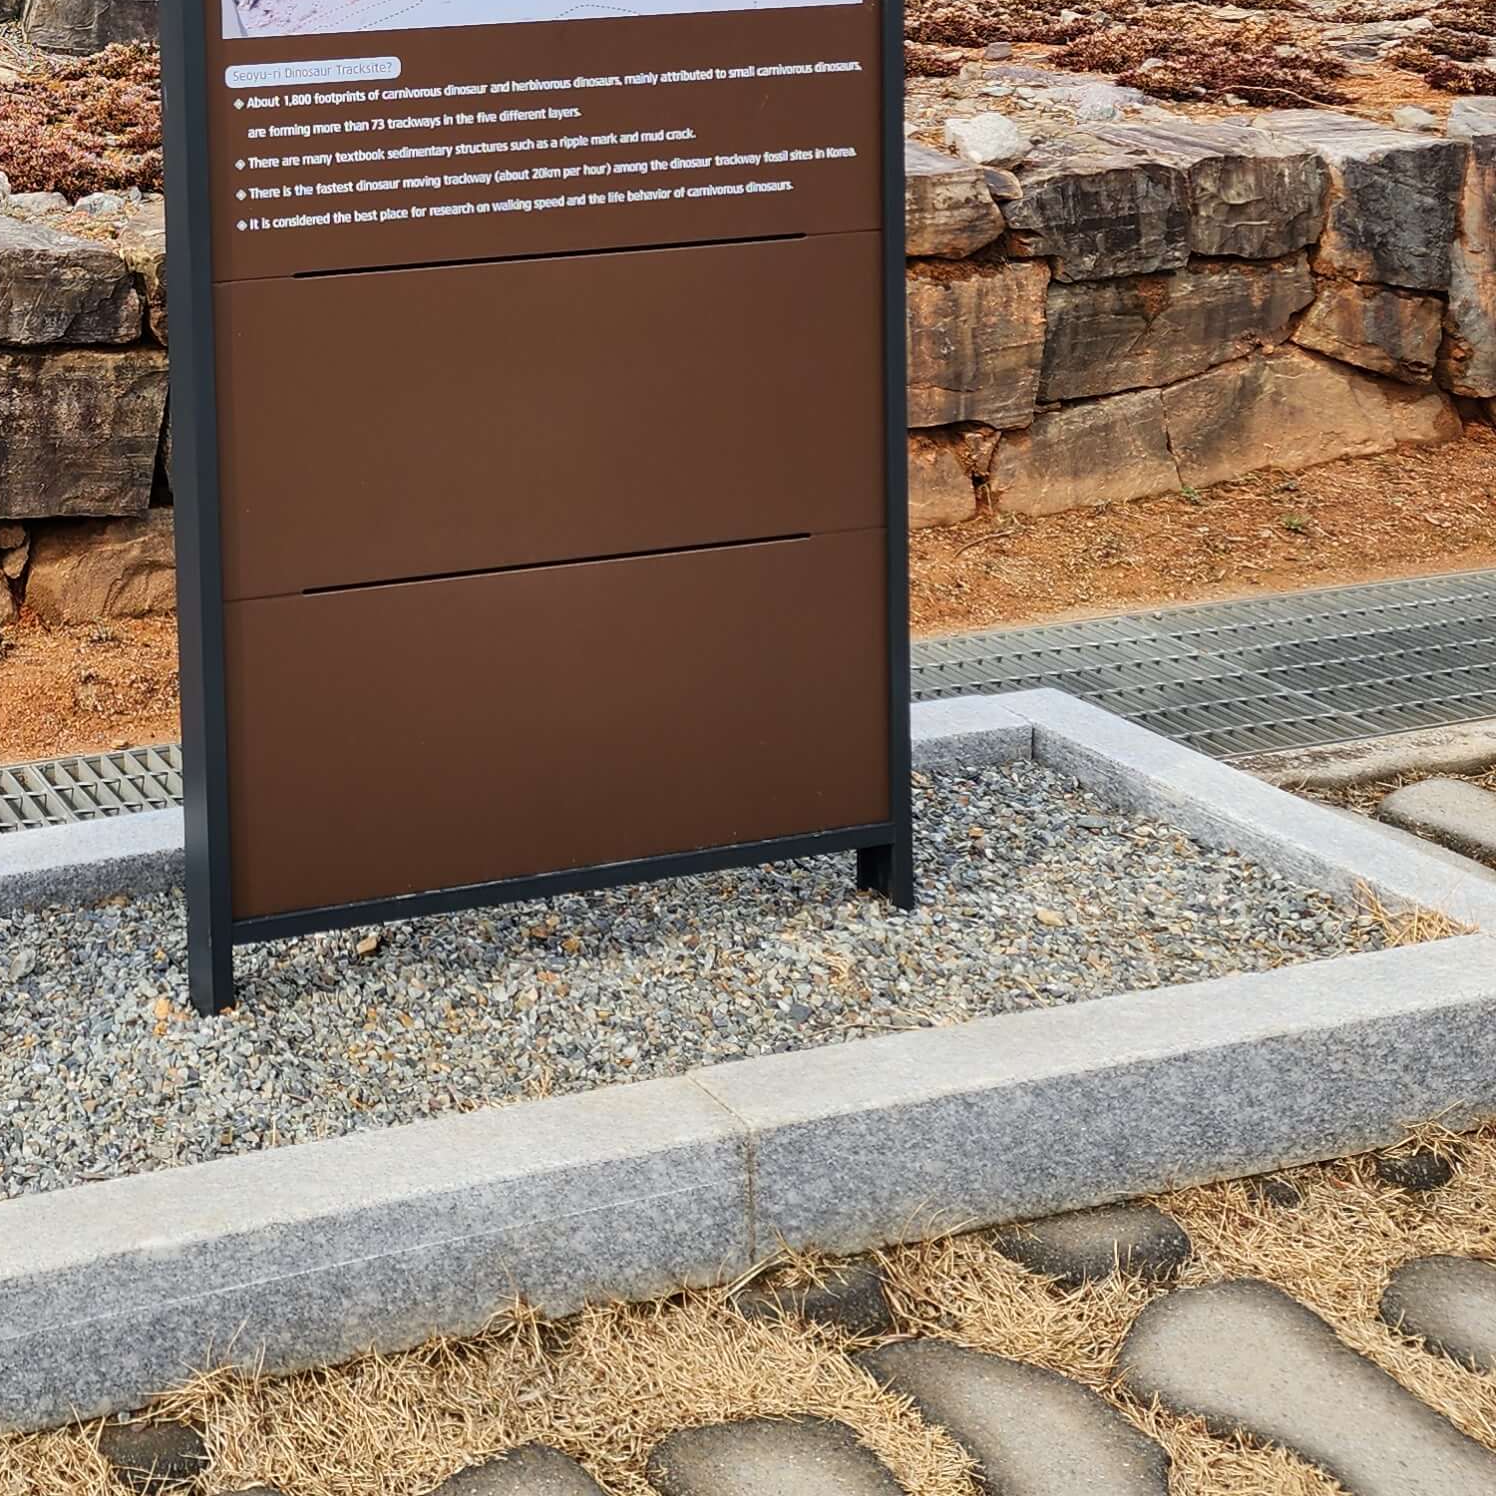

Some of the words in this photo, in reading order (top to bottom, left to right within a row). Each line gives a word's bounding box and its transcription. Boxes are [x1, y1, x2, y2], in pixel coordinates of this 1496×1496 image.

[233, 68, 280, 82] Seoyu-ri
[285, 67, 331, 79] Dinosaur
[336, 61, 392, 79] Tracksite?
[248, 128, 266, 138] are
[268, 124, 310, 136] forming
[313, 123, 341, 133] more
[344, 120, 369, 131] than
[371, 118, 384, 130] 73
[387, 116, 440, 128] trackways
[443, 114, 452, 125] in
[455, 112, 473, 124] the
[476, 111, 496, 122] five
[499, 108, 545, 121] different
[548, 107, 581, 119] layers.
[248, 156, 279, 168] There
[282, 156, 299, 166] are
[302, 154, 332, 165] many
[335, 148, 384, 162] textbook
[387, 146, 452, 158] sedimentary
[455, 142, 508, 154] structures
[510, 138, 534, 150] such
[536, 139, 548, 149] as
[559, 135, 588, 148] ripple
[590, 132, 617, 144] mark
[619, 131, 638, 143] and
[640, 129, 663, 141] mud
[665, 128, 695, 140] crack.
